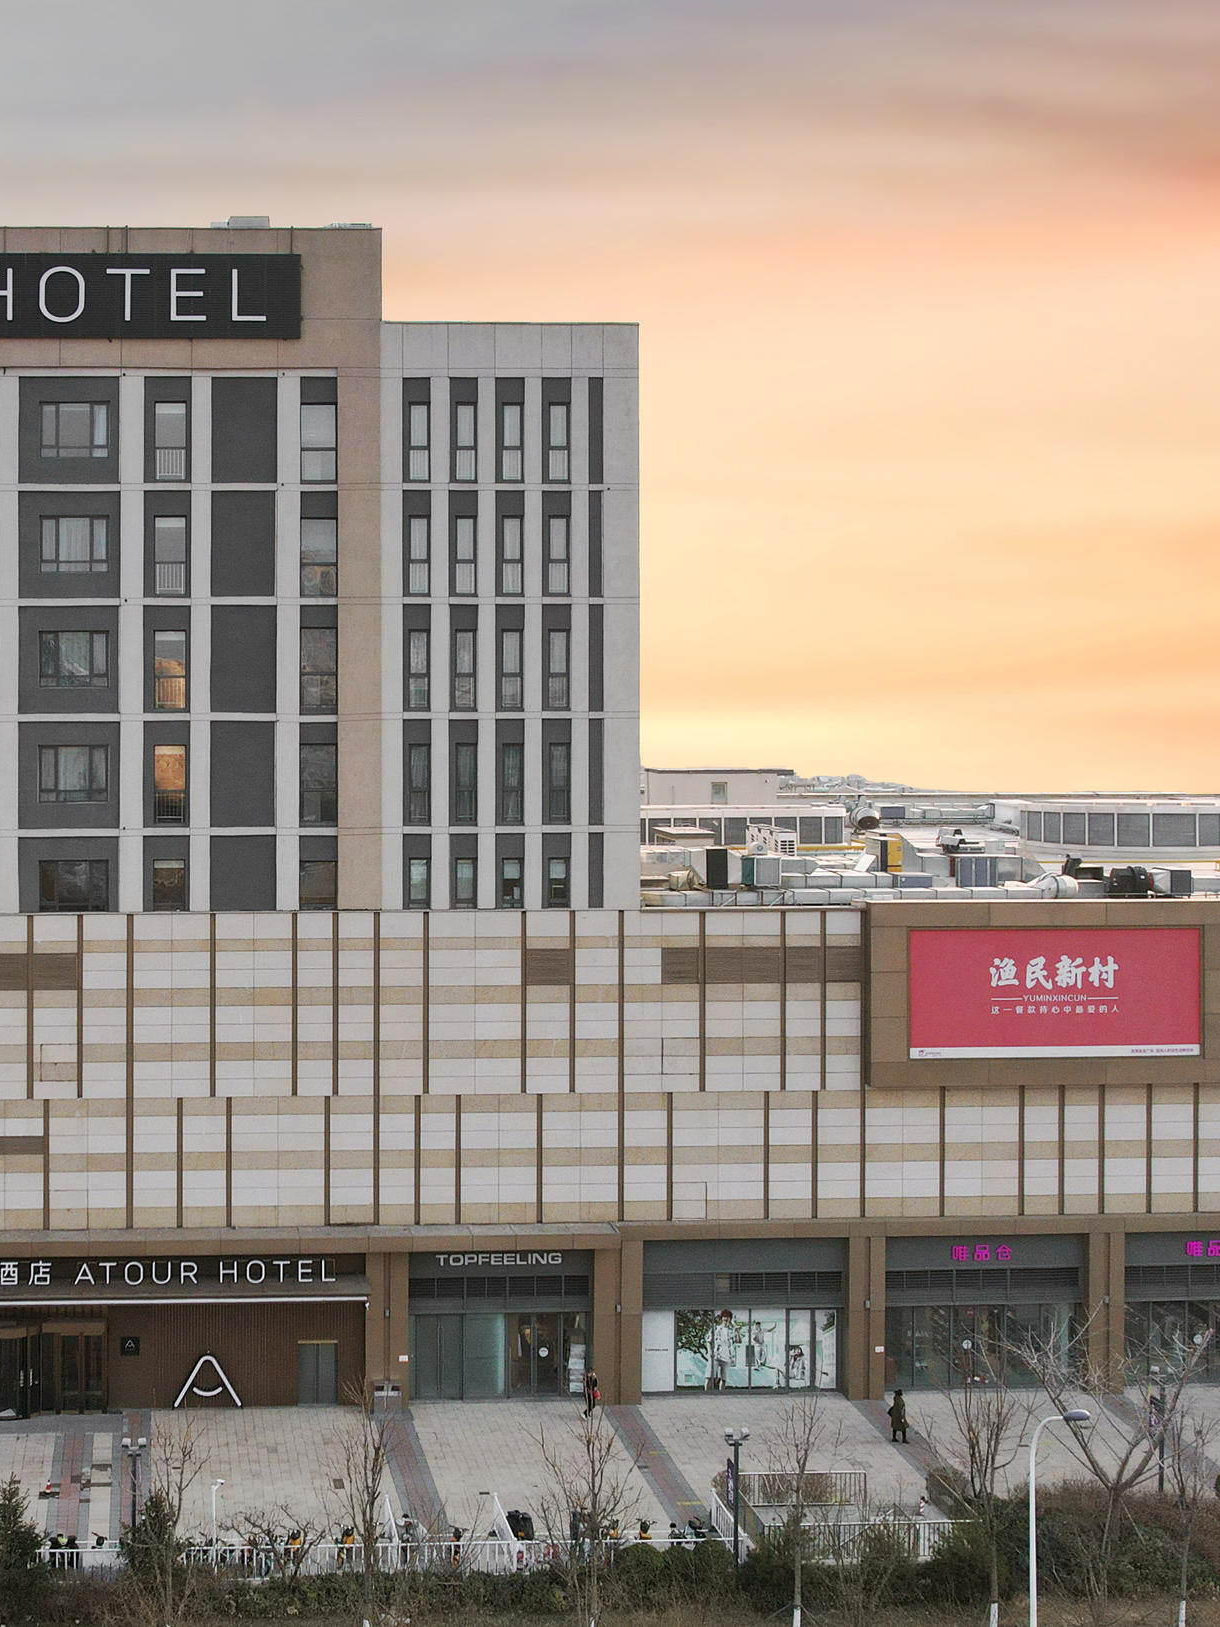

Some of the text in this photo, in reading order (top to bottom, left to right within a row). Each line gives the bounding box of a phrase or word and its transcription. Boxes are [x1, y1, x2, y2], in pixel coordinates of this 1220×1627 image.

[989, 954, 1119, 990] 渔民新村
[1023, 994, 1087, 1002] YUMINXINCUN
[436, 1253, 562, 1266] TOPFEELING
[952, 1244, 1012, 1261] 唯品仓
[74, 1261, 198, 1285] ATOUR
[219, 1259, 336, 1283] HOTEL
